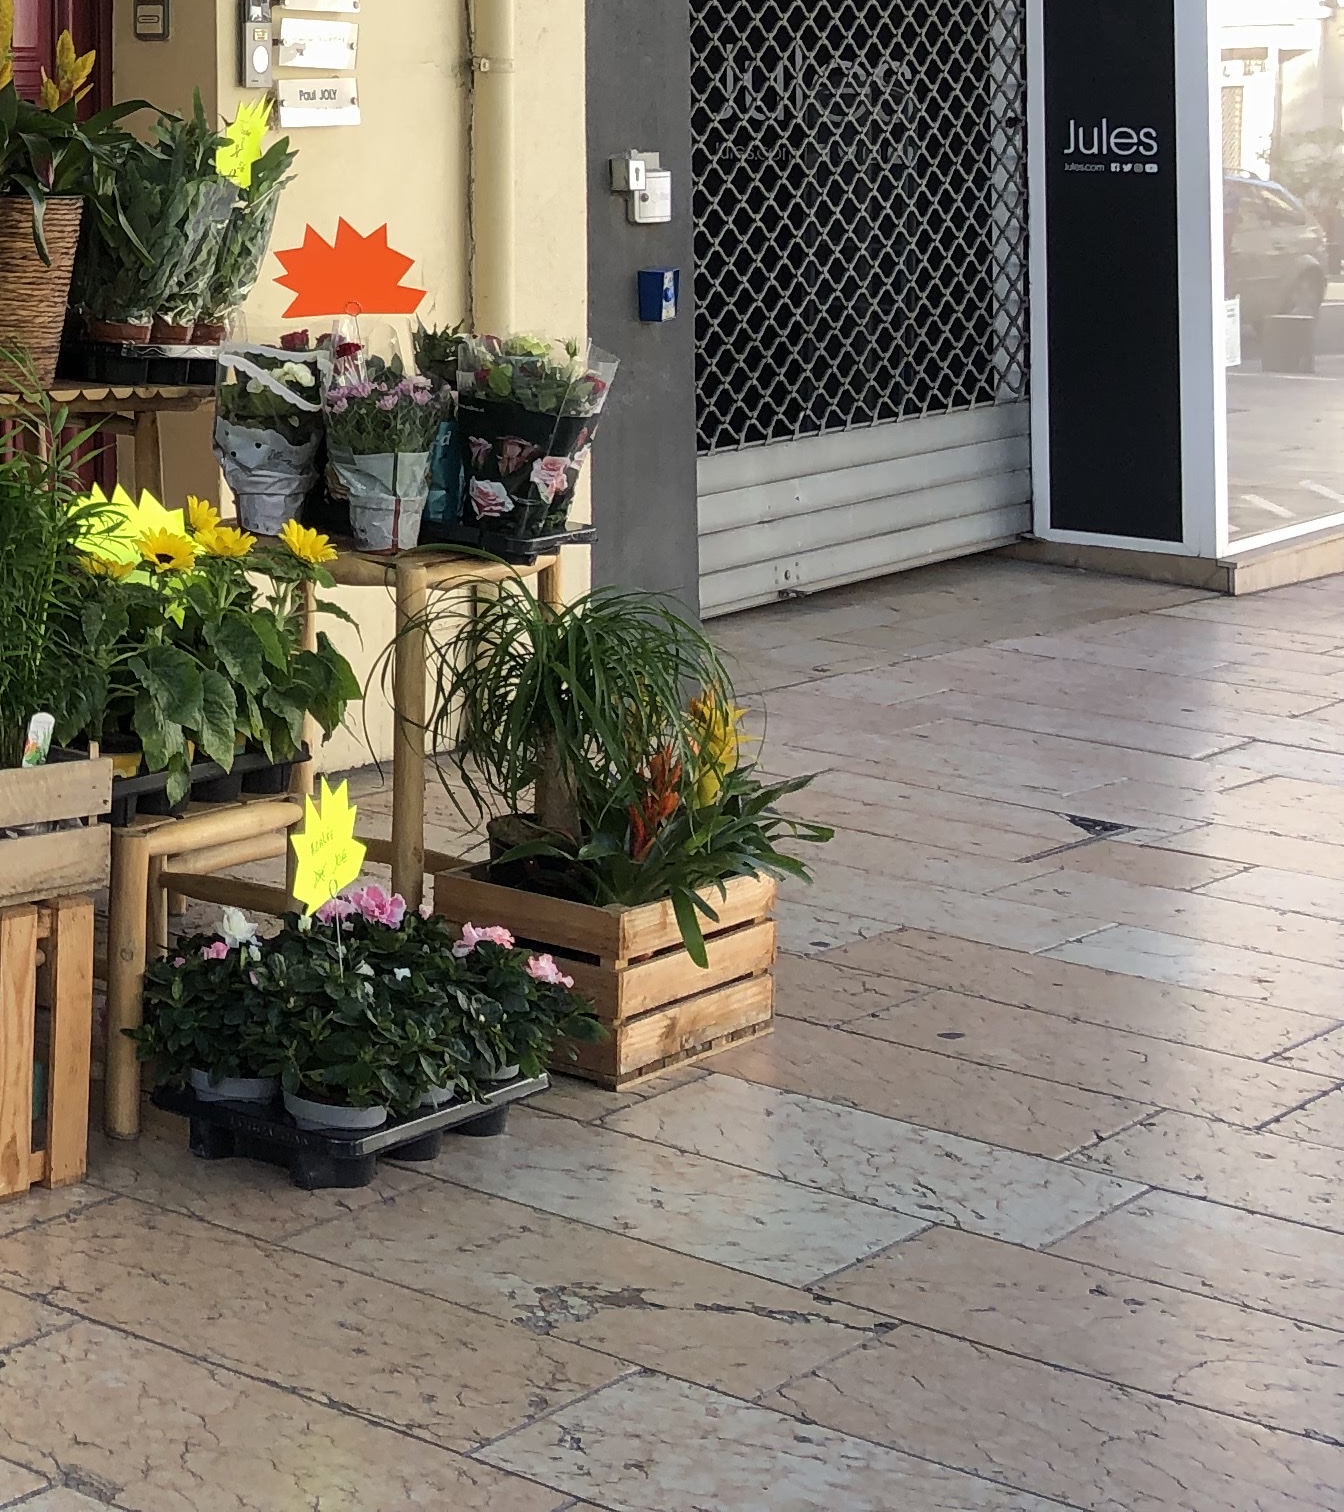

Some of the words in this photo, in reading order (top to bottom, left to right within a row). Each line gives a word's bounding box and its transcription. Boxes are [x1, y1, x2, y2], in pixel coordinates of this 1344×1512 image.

[298, 89, 317, 101] Paul
[319, 88, 338, 101] JOLY
[1063, 117, 1159, 156] Jules
